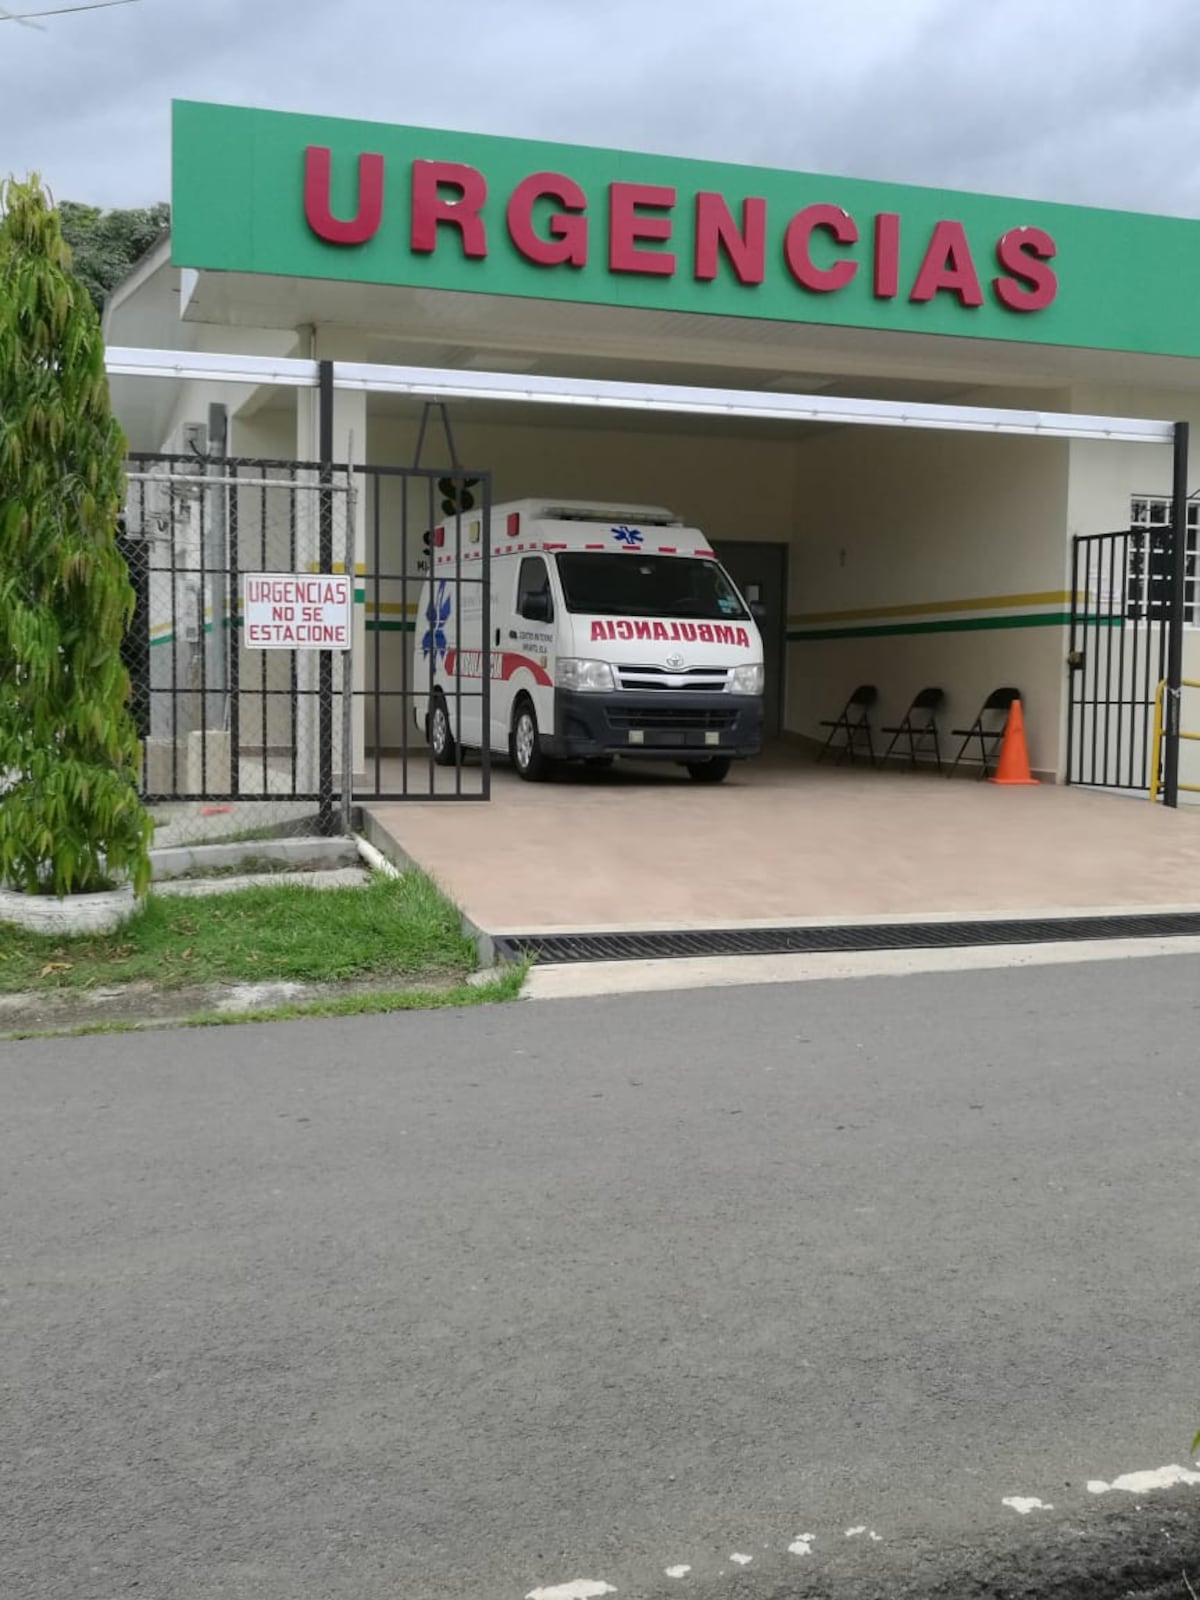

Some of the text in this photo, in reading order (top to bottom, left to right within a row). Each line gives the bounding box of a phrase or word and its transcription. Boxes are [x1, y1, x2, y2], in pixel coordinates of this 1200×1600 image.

[303, 145, 1059, 312] URGENCIAS
[249, 581, 347, 604] URGENCIAS
[272, 606, 323, 622] NO SE
[249, 625, 345, 642] ESTACIONE
